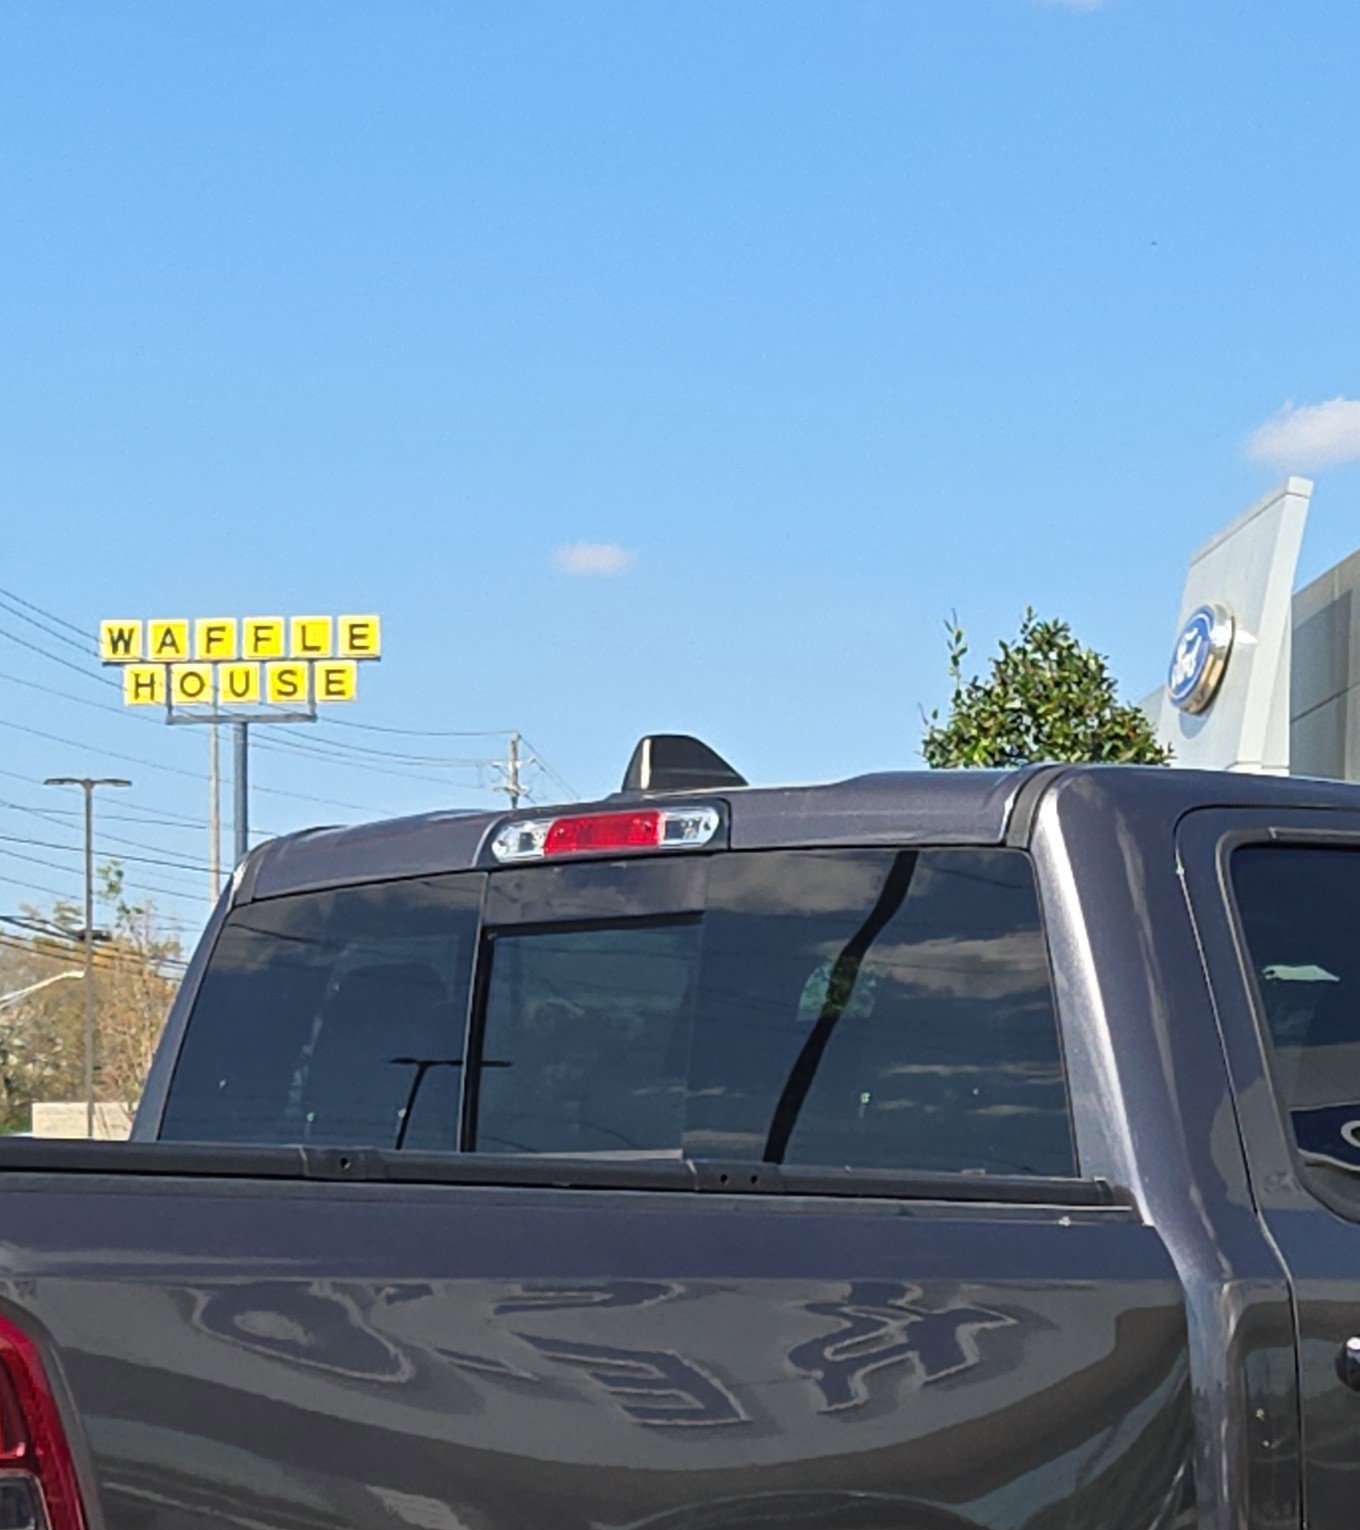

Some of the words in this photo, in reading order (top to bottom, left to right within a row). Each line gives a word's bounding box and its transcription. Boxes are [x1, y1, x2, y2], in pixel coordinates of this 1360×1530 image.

[107, 623, 370, 655] WAFFLE
[1171, 627, 1202, 690] Ford
[133, 669, 346, 700] HOUSE
